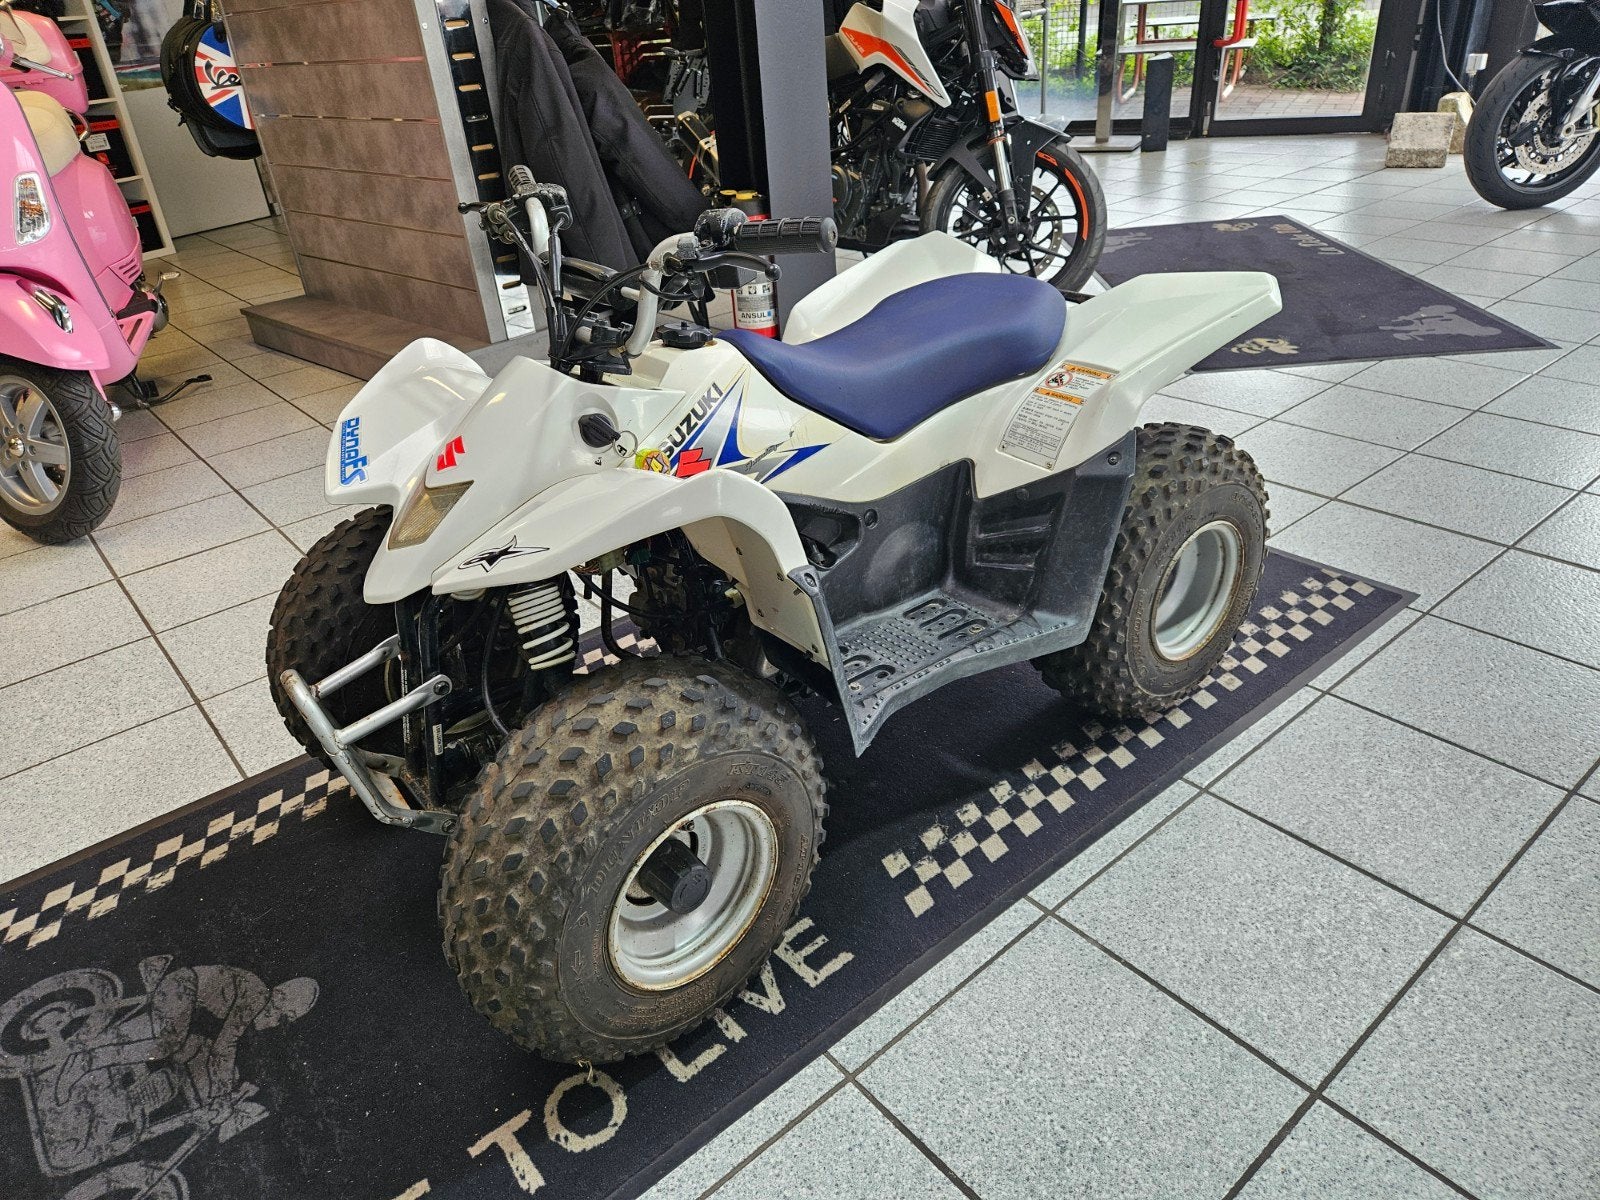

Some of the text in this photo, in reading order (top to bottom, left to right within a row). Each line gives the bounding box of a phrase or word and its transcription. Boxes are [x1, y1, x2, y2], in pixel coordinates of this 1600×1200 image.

[659, 382, 724, 459] SUZUKI
[467, 917, 854, 1194] TO LIVE
